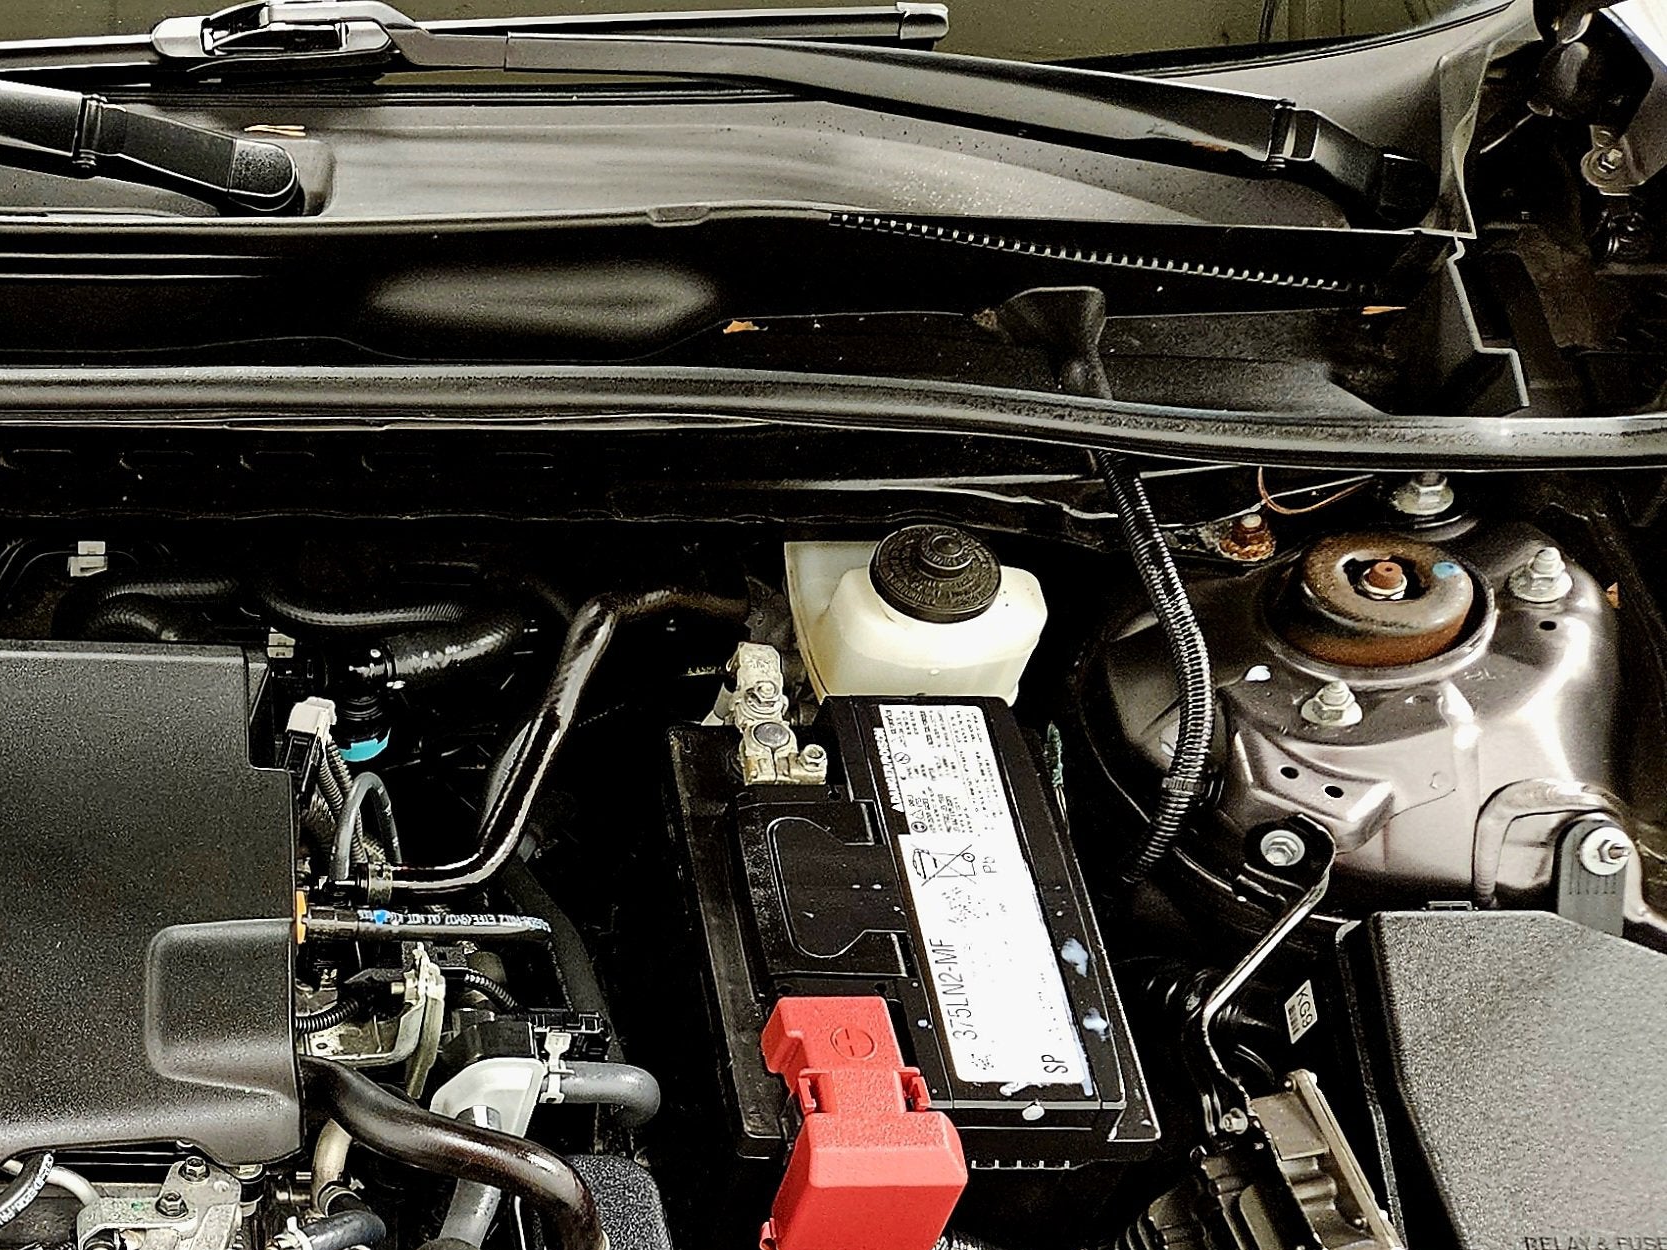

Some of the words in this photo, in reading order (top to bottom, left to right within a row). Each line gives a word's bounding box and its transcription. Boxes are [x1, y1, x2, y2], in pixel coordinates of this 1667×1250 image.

[929, 937, 978, 1041] 375LN2-MF
[1296, 986, 1313, 1028] KG9
[1041, 1054, 1069, 1075] SP
